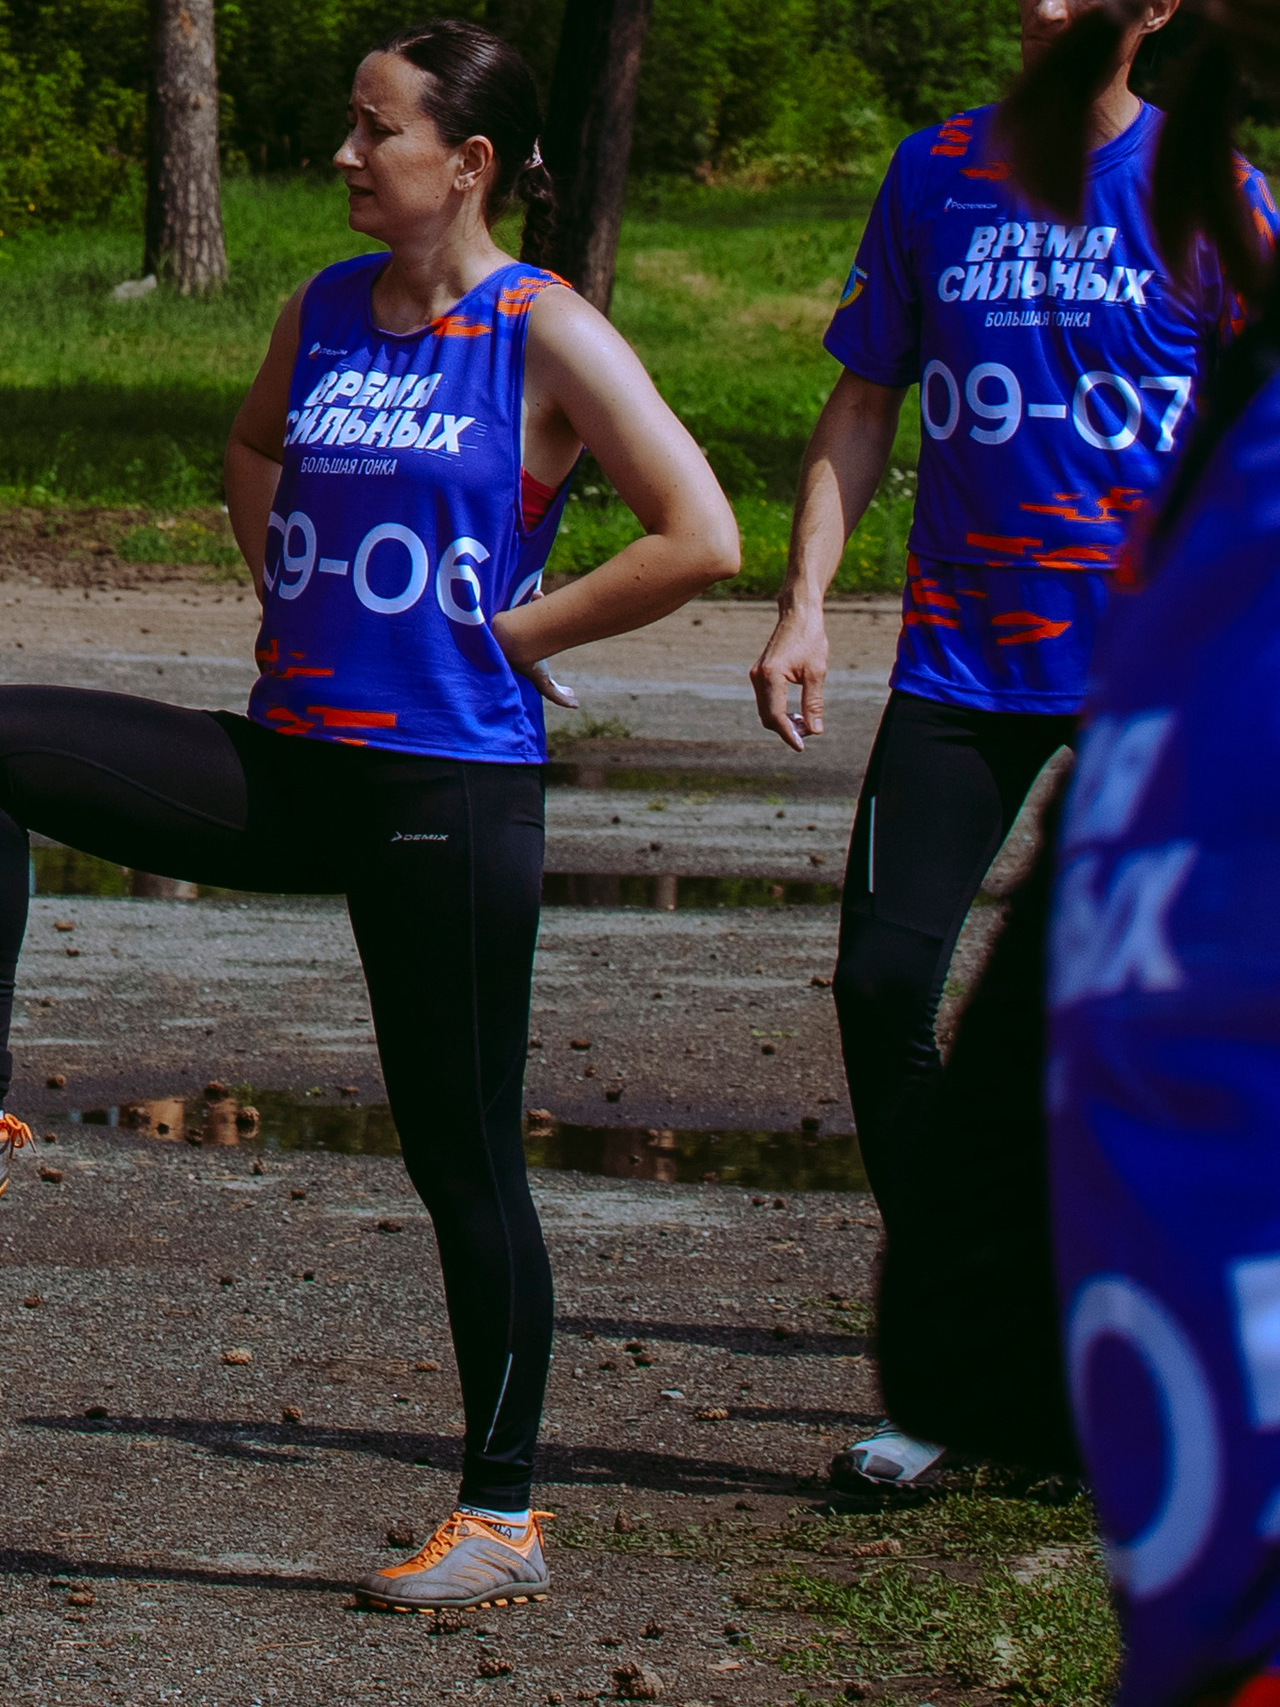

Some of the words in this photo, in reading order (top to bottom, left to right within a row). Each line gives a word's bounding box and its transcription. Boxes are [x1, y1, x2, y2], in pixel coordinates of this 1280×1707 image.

[965, 221, 1117, 263] ВРЕМЯ
[937, 260, 1155, 306] СИЛЬНЫХ
[984, 310, 1051, 327] БОЛЬШАЯ
[303, 370, 443, 409] ВРЕМЯ
[920, 359, 1192, 452] 09-07
[300, 456, 359, 474] БОЛЬШАЯ
[358, 458, 398, 475] ГОНКА
[263, 510, 491, 626] 09-06
[402, 833, 450, 841] DEMIX
